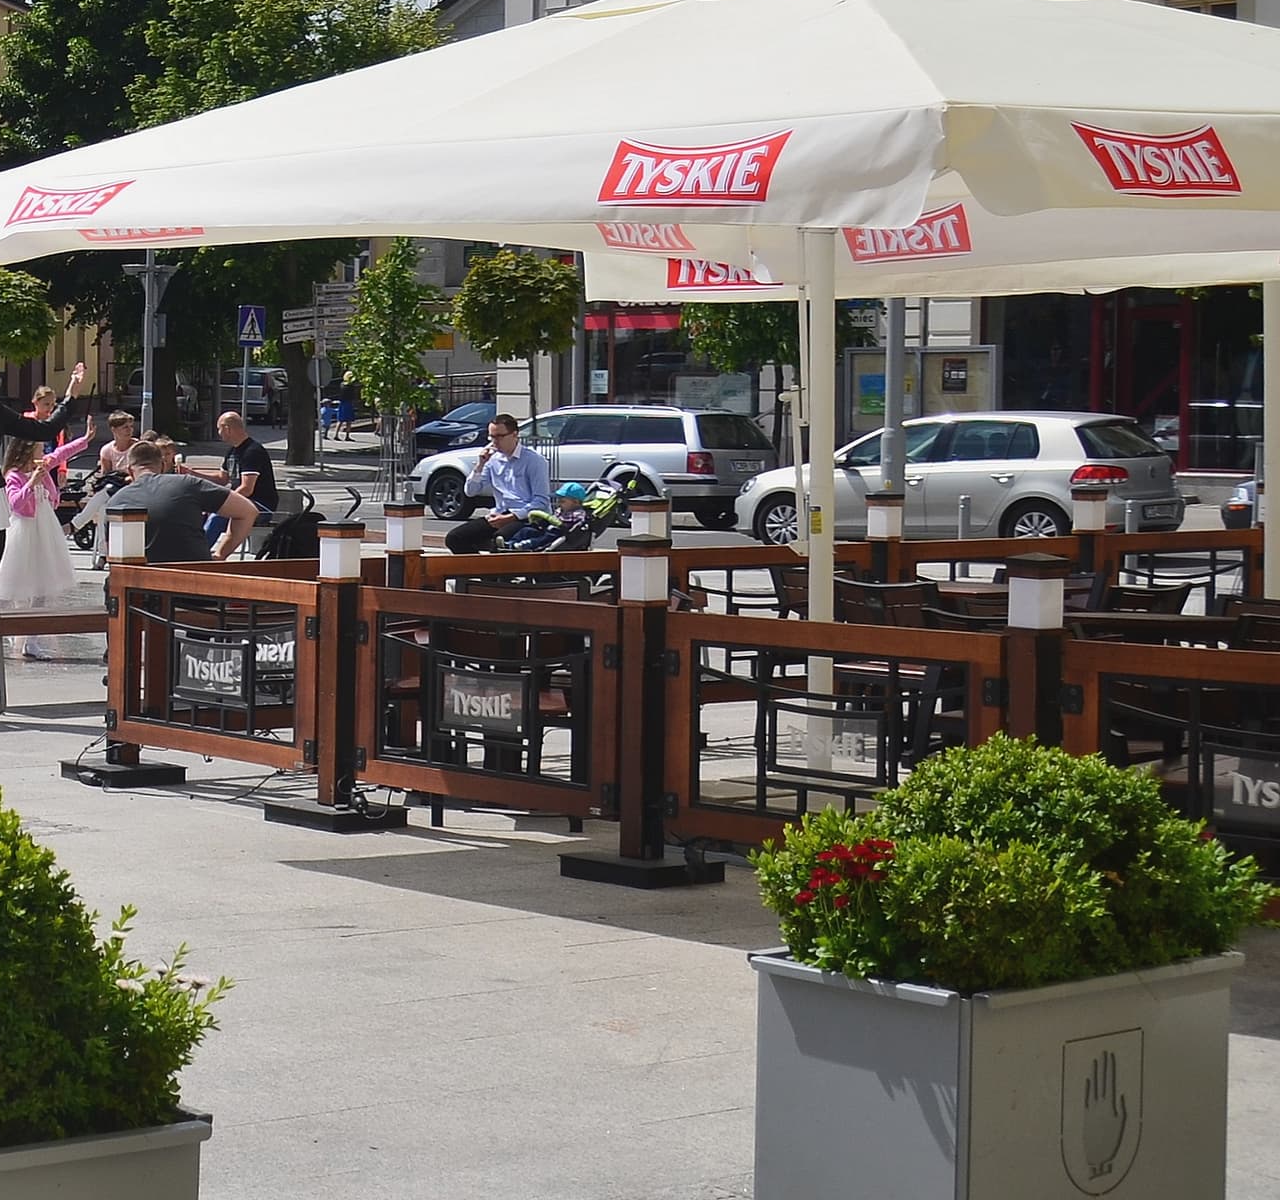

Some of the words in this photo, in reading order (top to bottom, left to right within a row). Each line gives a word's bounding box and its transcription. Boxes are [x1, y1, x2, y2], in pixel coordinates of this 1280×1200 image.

[612, 145, 768, 196] TYSKIE
[1094, 136, 1232, 186] TYSKIE
[10, 186, 118, 222] TYSKIE
[185, 654, 235, 685] TYSKIE
[450, 687, 512, 720] TYSKIE
[1231, 771, 1280, 809] TYS
